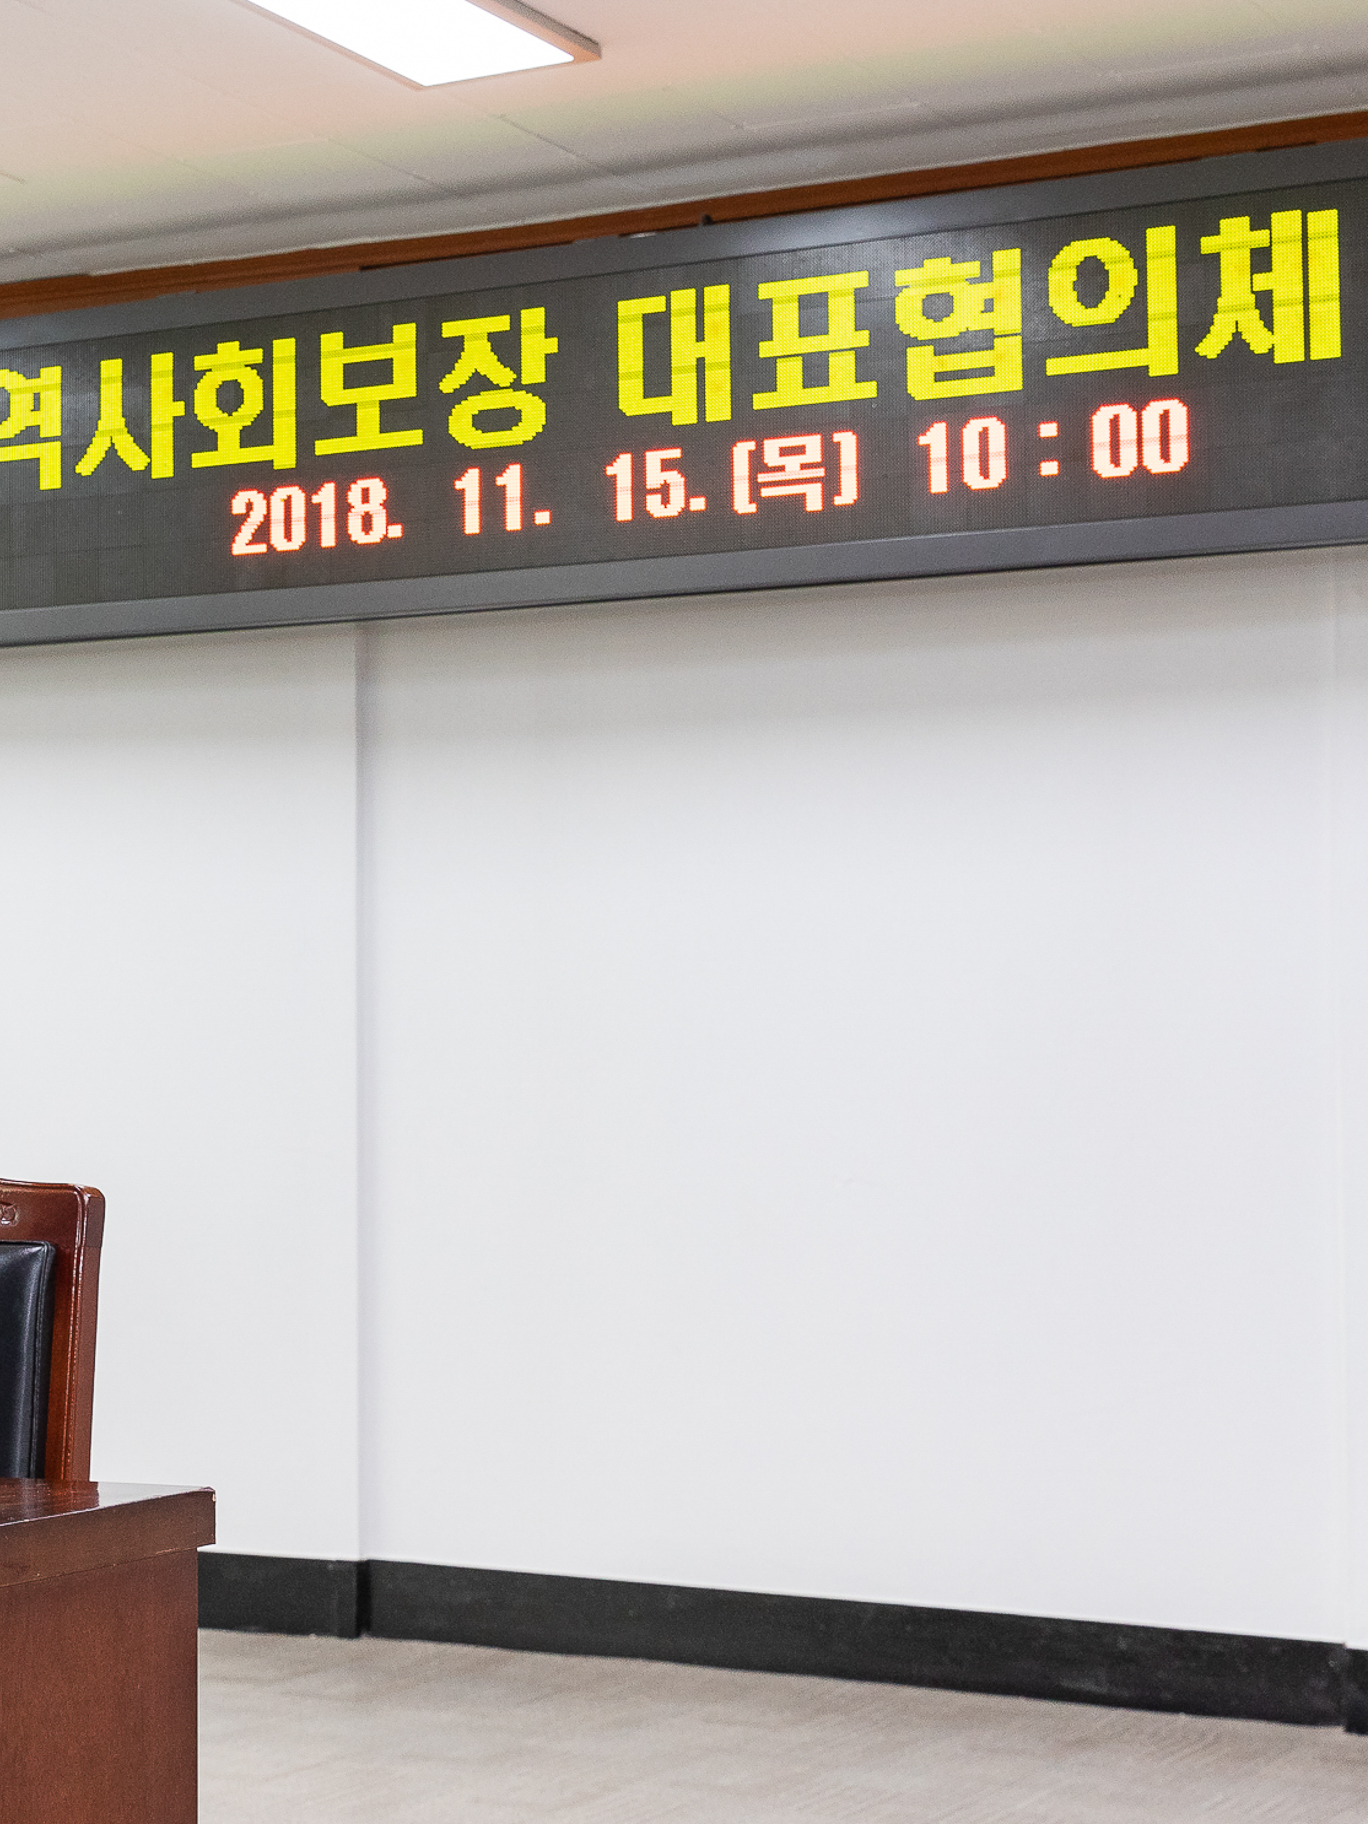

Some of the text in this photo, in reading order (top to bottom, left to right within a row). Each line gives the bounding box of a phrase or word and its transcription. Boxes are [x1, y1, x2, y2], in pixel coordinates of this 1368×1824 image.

[616, 208, 1343, 427] 대표협의체
[230, 476, 405, 557] 2018.
[453, 462, 553, 536] 11.
